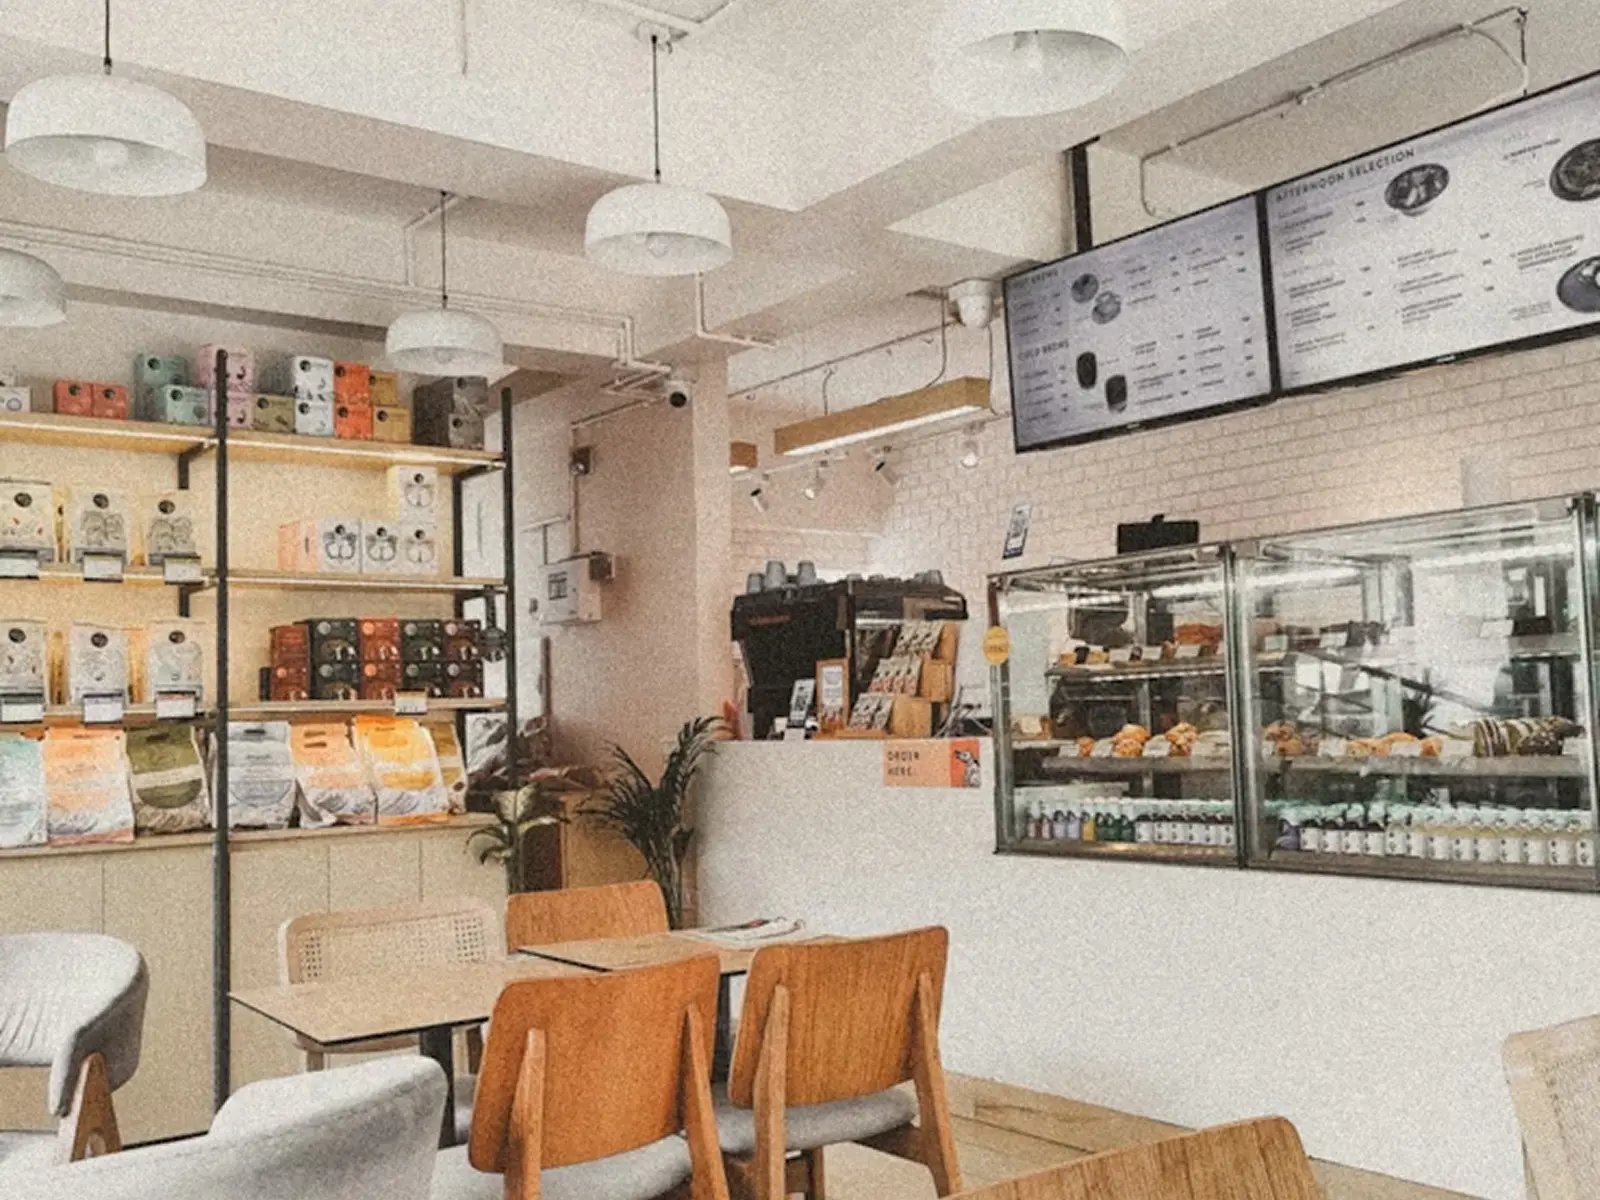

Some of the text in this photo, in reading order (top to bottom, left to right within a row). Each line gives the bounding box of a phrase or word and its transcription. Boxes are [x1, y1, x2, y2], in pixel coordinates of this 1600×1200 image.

[1276, 147, 1415, 202] AFTERNOON SELECTION
[887, 751, 919, 761] ORDER
